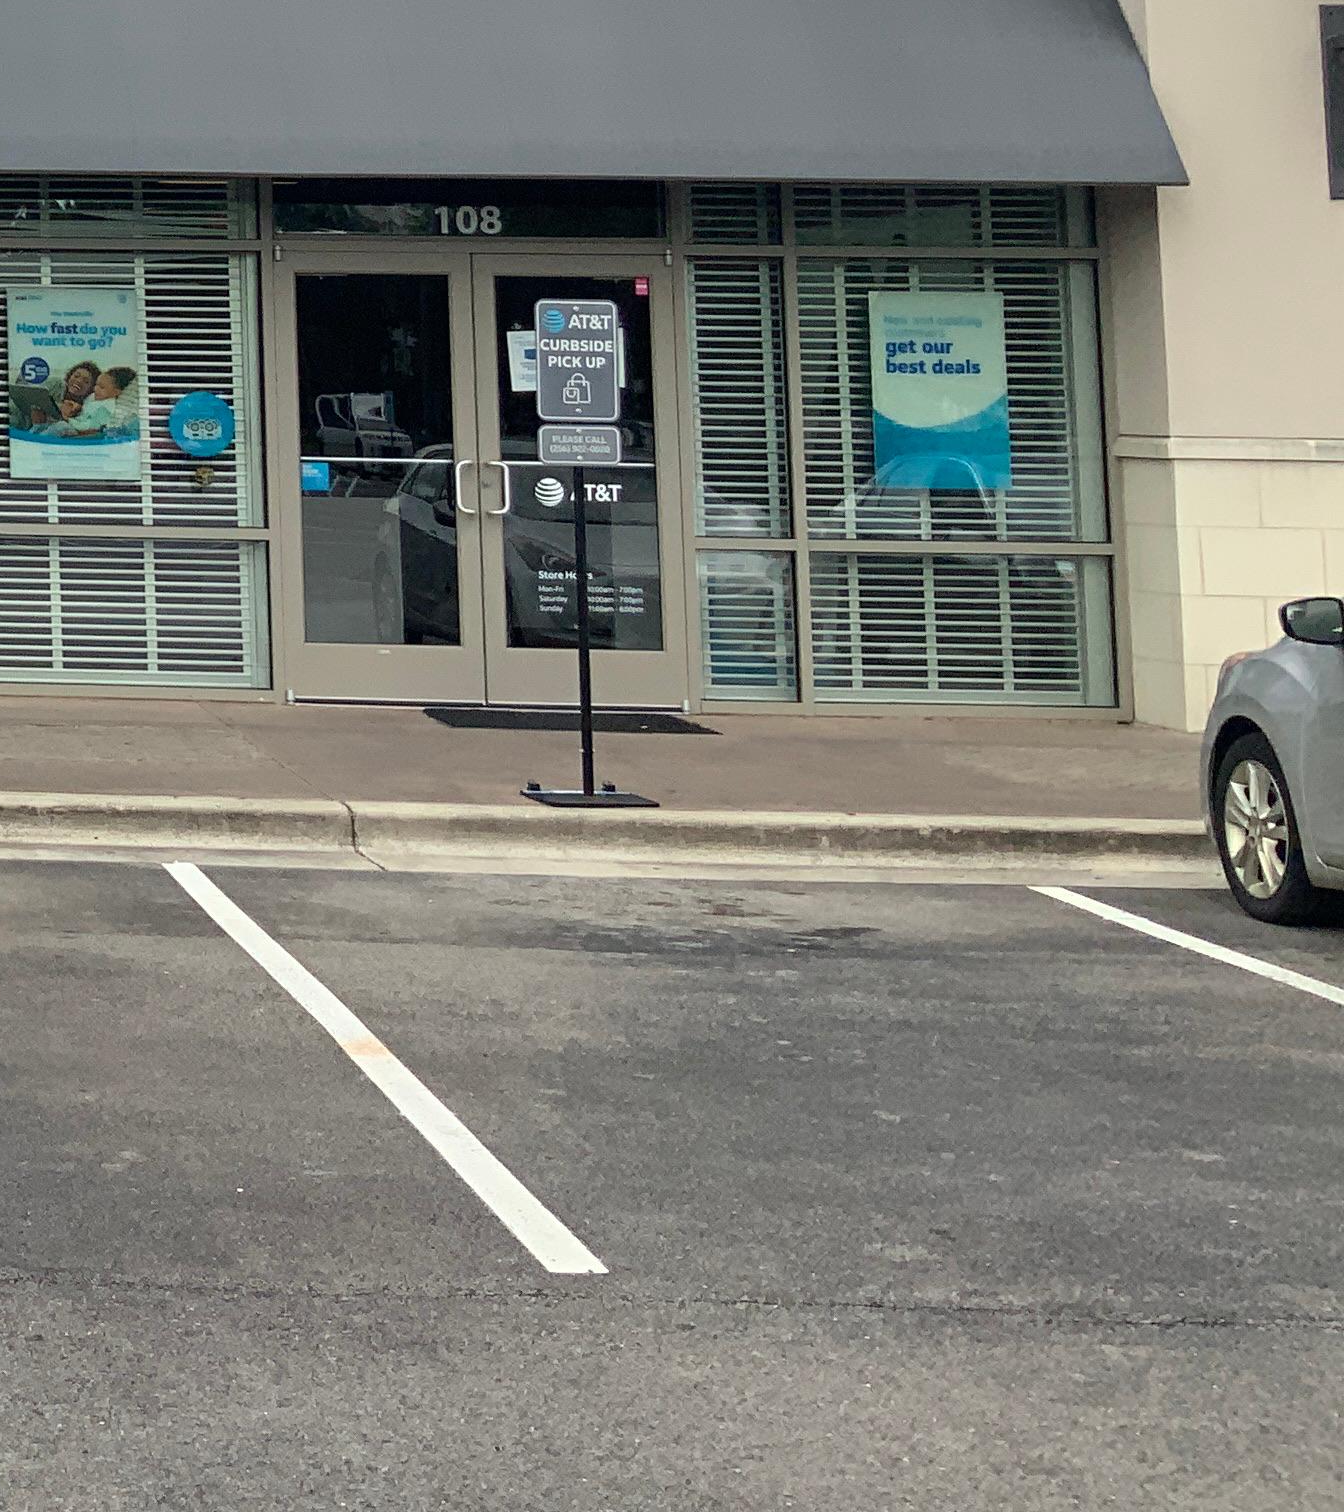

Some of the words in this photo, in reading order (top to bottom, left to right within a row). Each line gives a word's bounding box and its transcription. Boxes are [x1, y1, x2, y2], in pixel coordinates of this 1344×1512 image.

[434, 204, 503, 235] 108
[16, 322, 48, 334] How
[50, 321, 79, 334] fast
[80, 322, 98, 334] do
[100, 325, 127, 337] you
[568, 314, 612, 330] AT&T
[31, 336, 68, 347] want
[69, 336, 86, 347] to
[87, 336, 114, 350] go?
[540, 338, 614, 353] CURBSIDE
[885, 340, 918, 358] get
[922, 342, 954, 355] our
[547, 355, 583, 369] PICK
[585, 356, 606, 369] UP
[885, 358, 927, 375] best
[931, 358, 982, 375] deals
[24, 364, 36, 380] 5
[551, 434, 584, 444] PLEASE
[584, 435, 608, 445] CALL
[570, 483, 623, 502] T&T
[538, 570, 564, 580] Store
[565, 570, 593, 580] Hos
[537, 585, 565, 593] Mon-Fri
[538, 594, 568, 604] Saturday
[539, 605, 564, 614] Sunday
